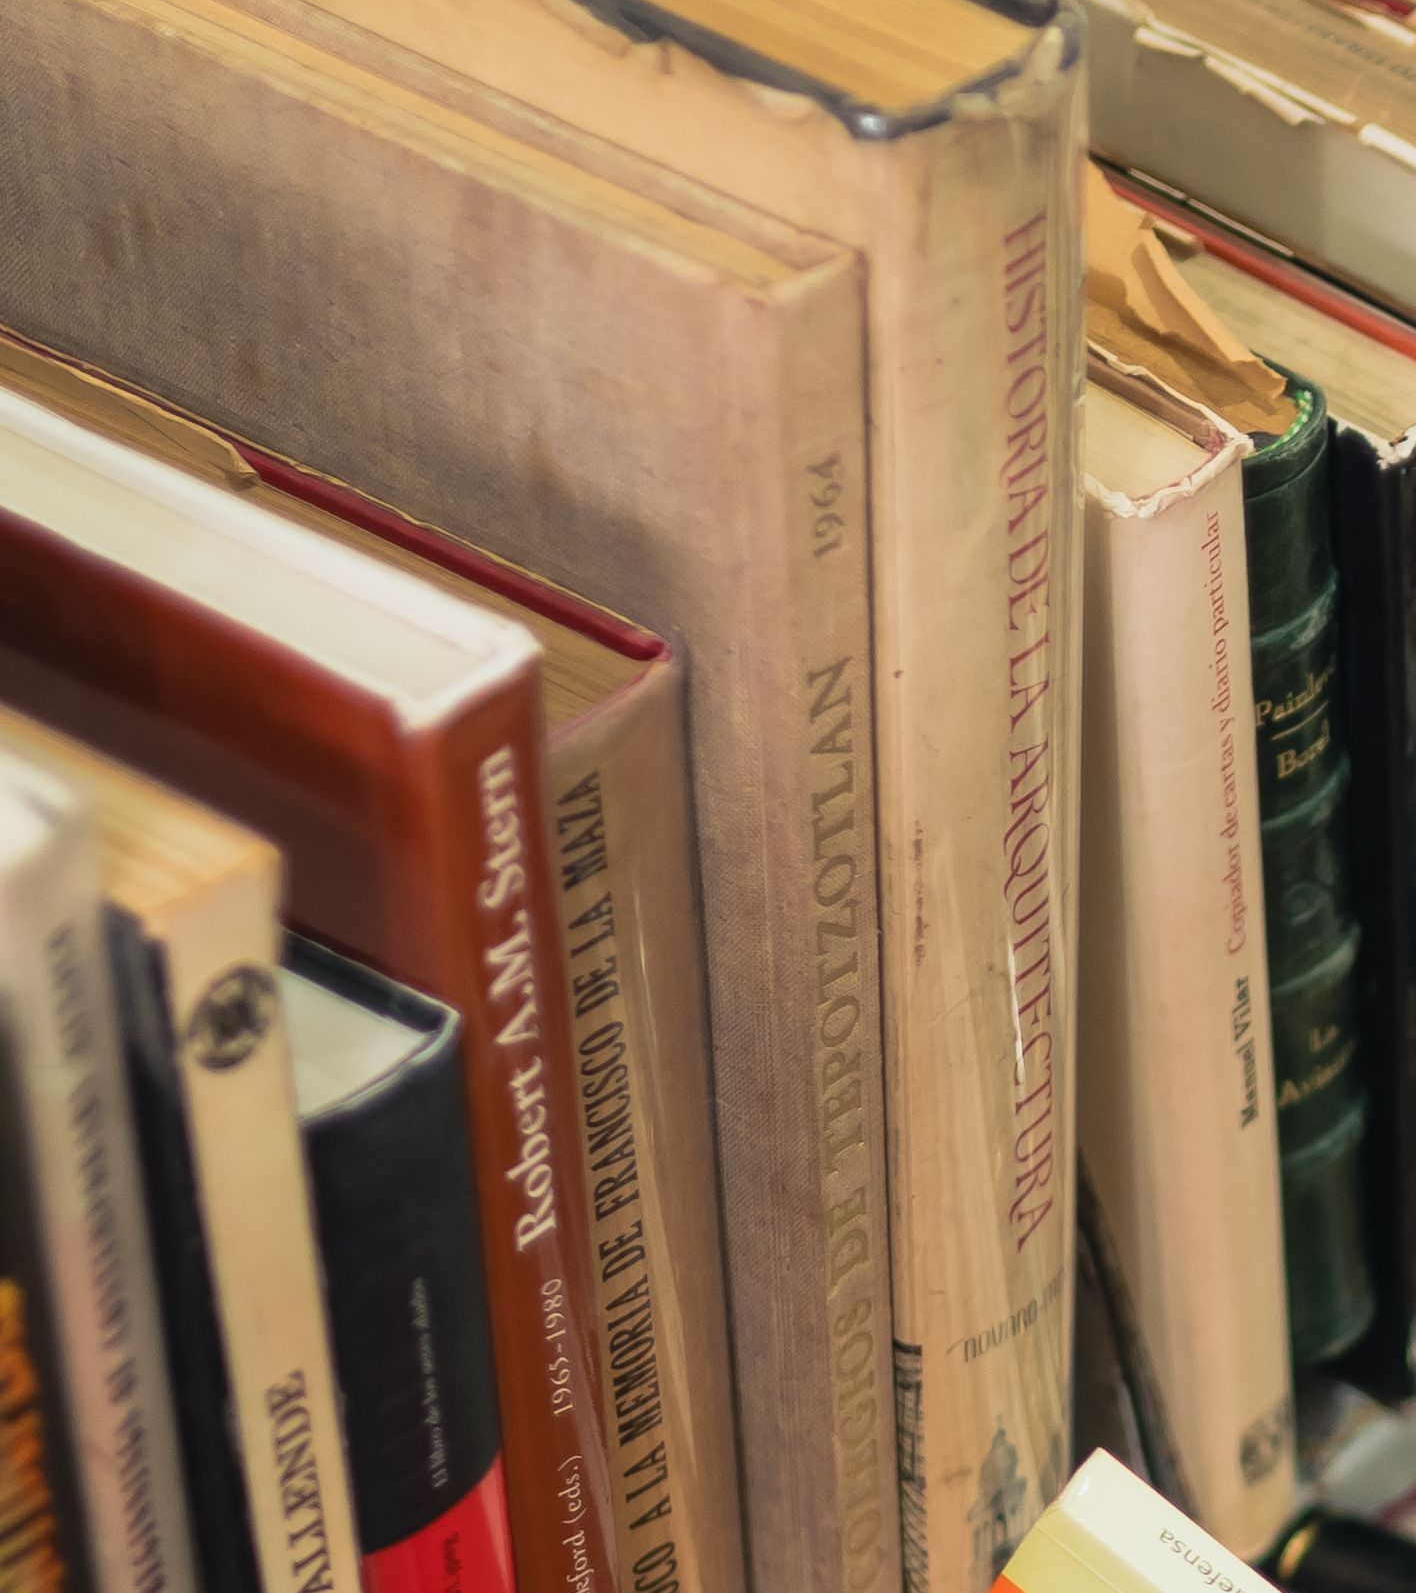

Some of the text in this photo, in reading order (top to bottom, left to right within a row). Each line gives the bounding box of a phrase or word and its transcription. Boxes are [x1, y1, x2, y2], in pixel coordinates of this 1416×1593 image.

[992, 215, 1065, 1254] HISTORIA DE LA ARQUITECTURA
[551, 768, 609, 887] MAZA
[806, 456, 870, 1173] TEPOTZOTLAN 1964
[564, 895, 615, 953] LA
[570, 951, 621, 1012] DE
[464, 743, 561, 1251] Robert A.M. Stern
[577, 1016, 642, 1216] FRANCISCO
[598, 1220, 648, 1279] DE
[537, 1276, 576, 1417] 1965-1980
[604, 1274, 665, 1444] MEMORIA
[555, 1453, 590, 1520] (eds.)
[621, 1441, 670, 1497] LA
[627, 1497, 673, 1528] A
